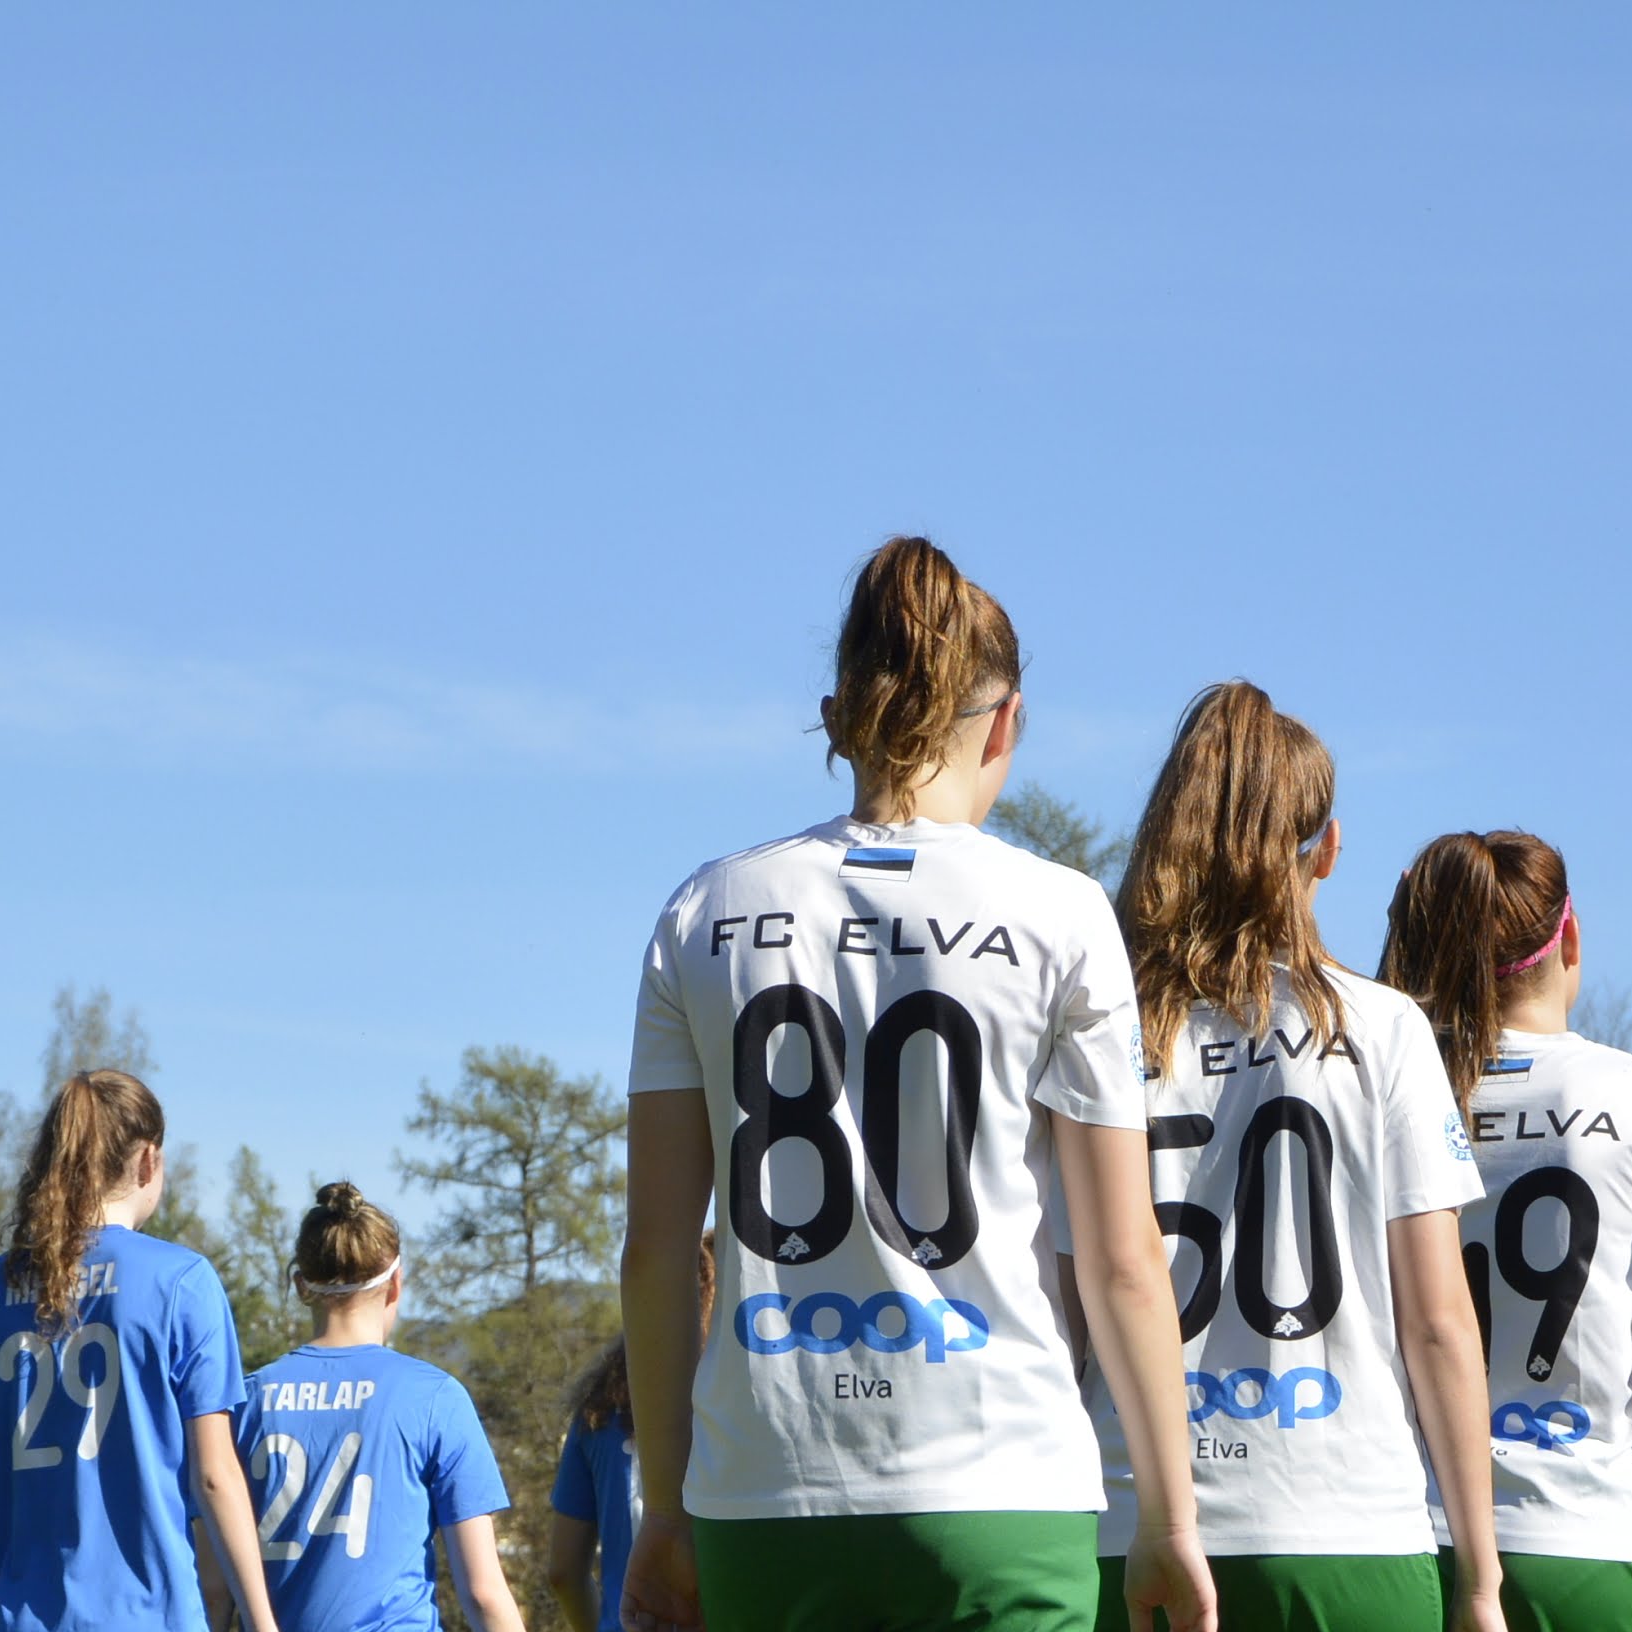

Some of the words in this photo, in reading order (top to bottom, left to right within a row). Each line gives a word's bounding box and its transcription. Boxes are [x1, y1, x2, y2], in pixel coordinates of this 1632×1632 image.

[710, 912, 795, 957] FC
[837, 916, 1021, 967] ELVA
[1200, 1028, 1360, 1076] ELVA
[728, 983, 983, 1271] 80
[1471, 1109, 1621, 1142] ELVA
[1147, 1095, 1345, 1345] 50
[733, 1291, 990, 1364] coop
[262, 1380, 375, 1413] TARLAP
[833, 1373, 893, 1400] Elva
[1184, 1366, 1343, 1429] oop
[1196, 1437, 1248, 1459] Elva
[251, 1432, 373, 1561] 24
